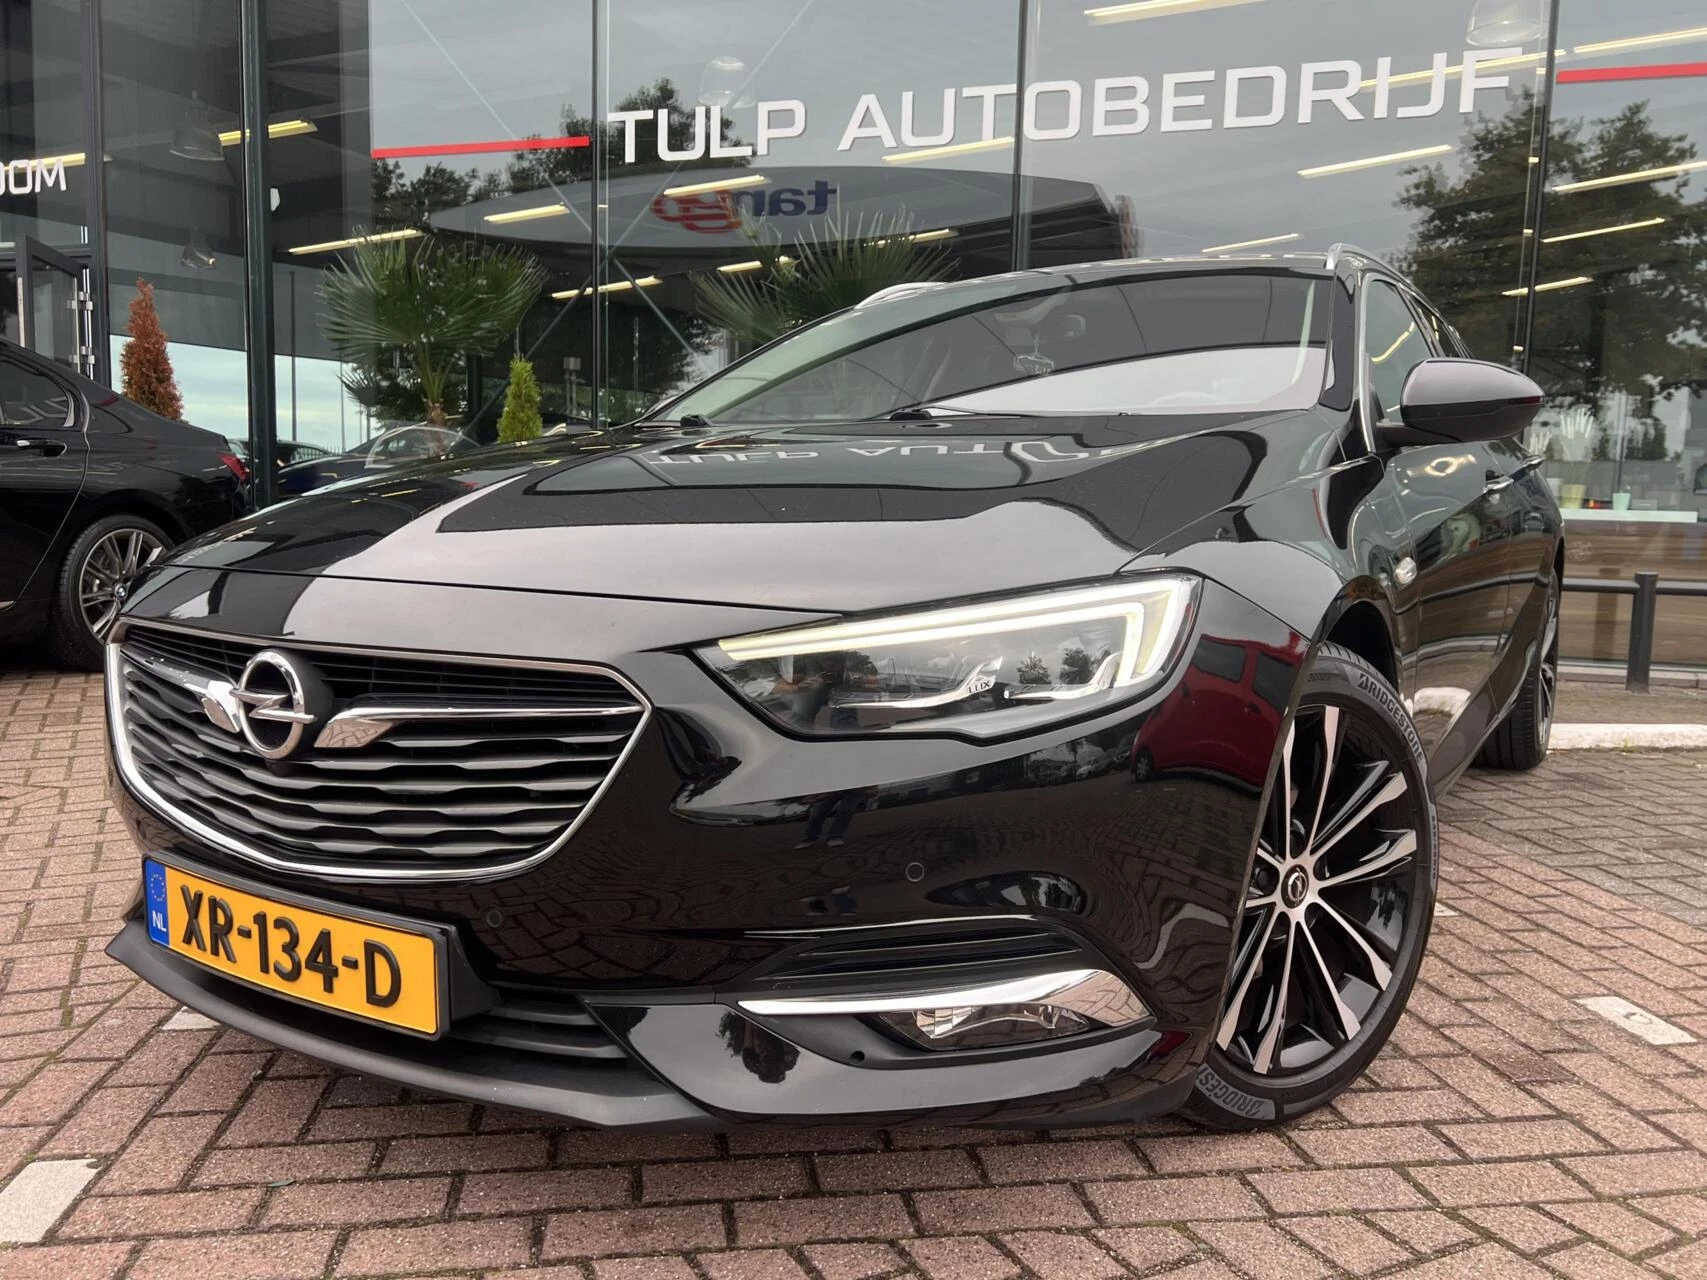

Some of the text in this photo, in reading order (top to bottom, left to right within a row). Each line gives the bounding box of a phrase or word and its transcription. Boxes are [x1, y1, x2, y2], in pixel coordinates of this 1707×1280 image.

[607, 46, 1523, 164] TULP AUTOBEDRIJF
[0, 158, 67, 196] OM
[1357, 672, 1424, 761] BRIDGESTONE
[152, 910, 167, 933] NL
[180, 884, 402, 1009] XR-134-D
